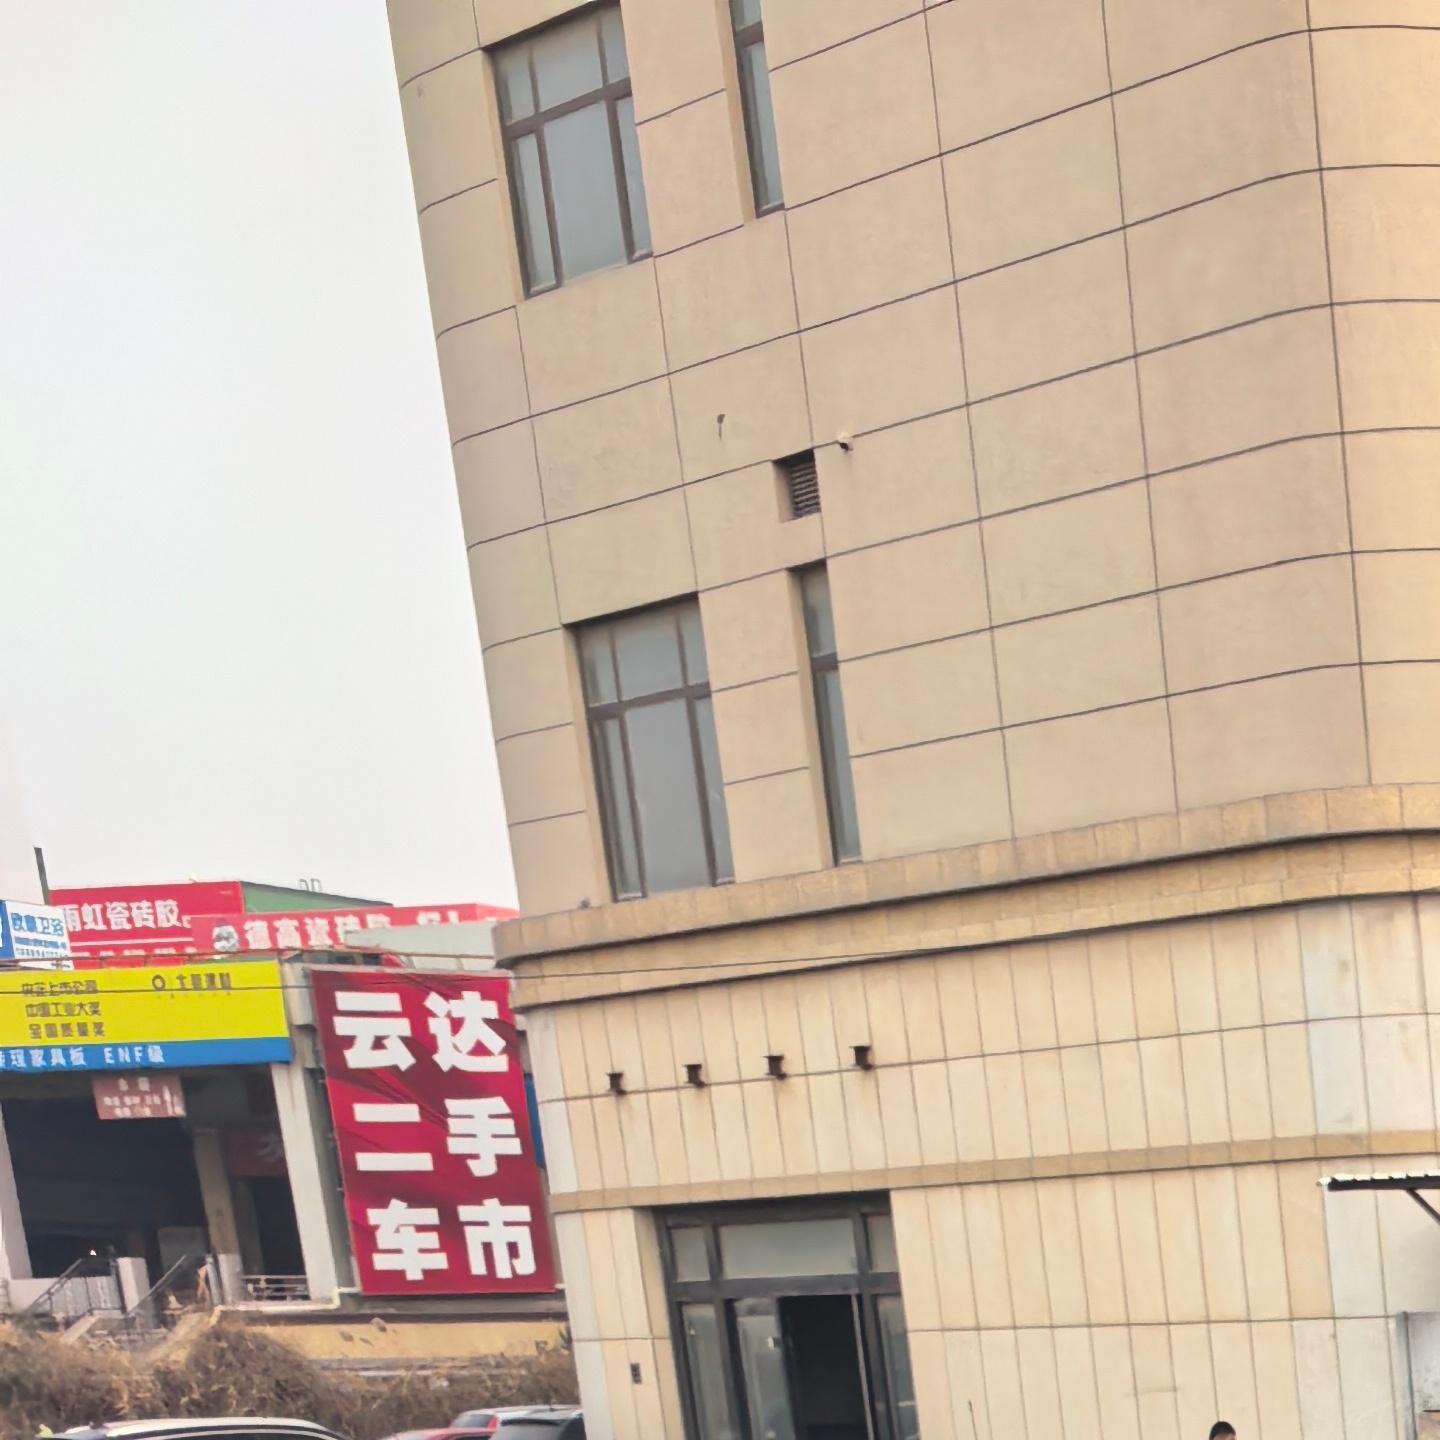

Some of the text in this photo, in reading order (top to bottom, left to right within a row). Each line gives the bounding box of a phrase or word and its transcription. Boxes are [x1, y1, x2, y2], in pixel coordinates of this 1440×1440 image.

[333, 989, 509, 1073] 云达
[352, 1095, 523, 1178] 二手
[367, 1197, 537, 1282] 车市
